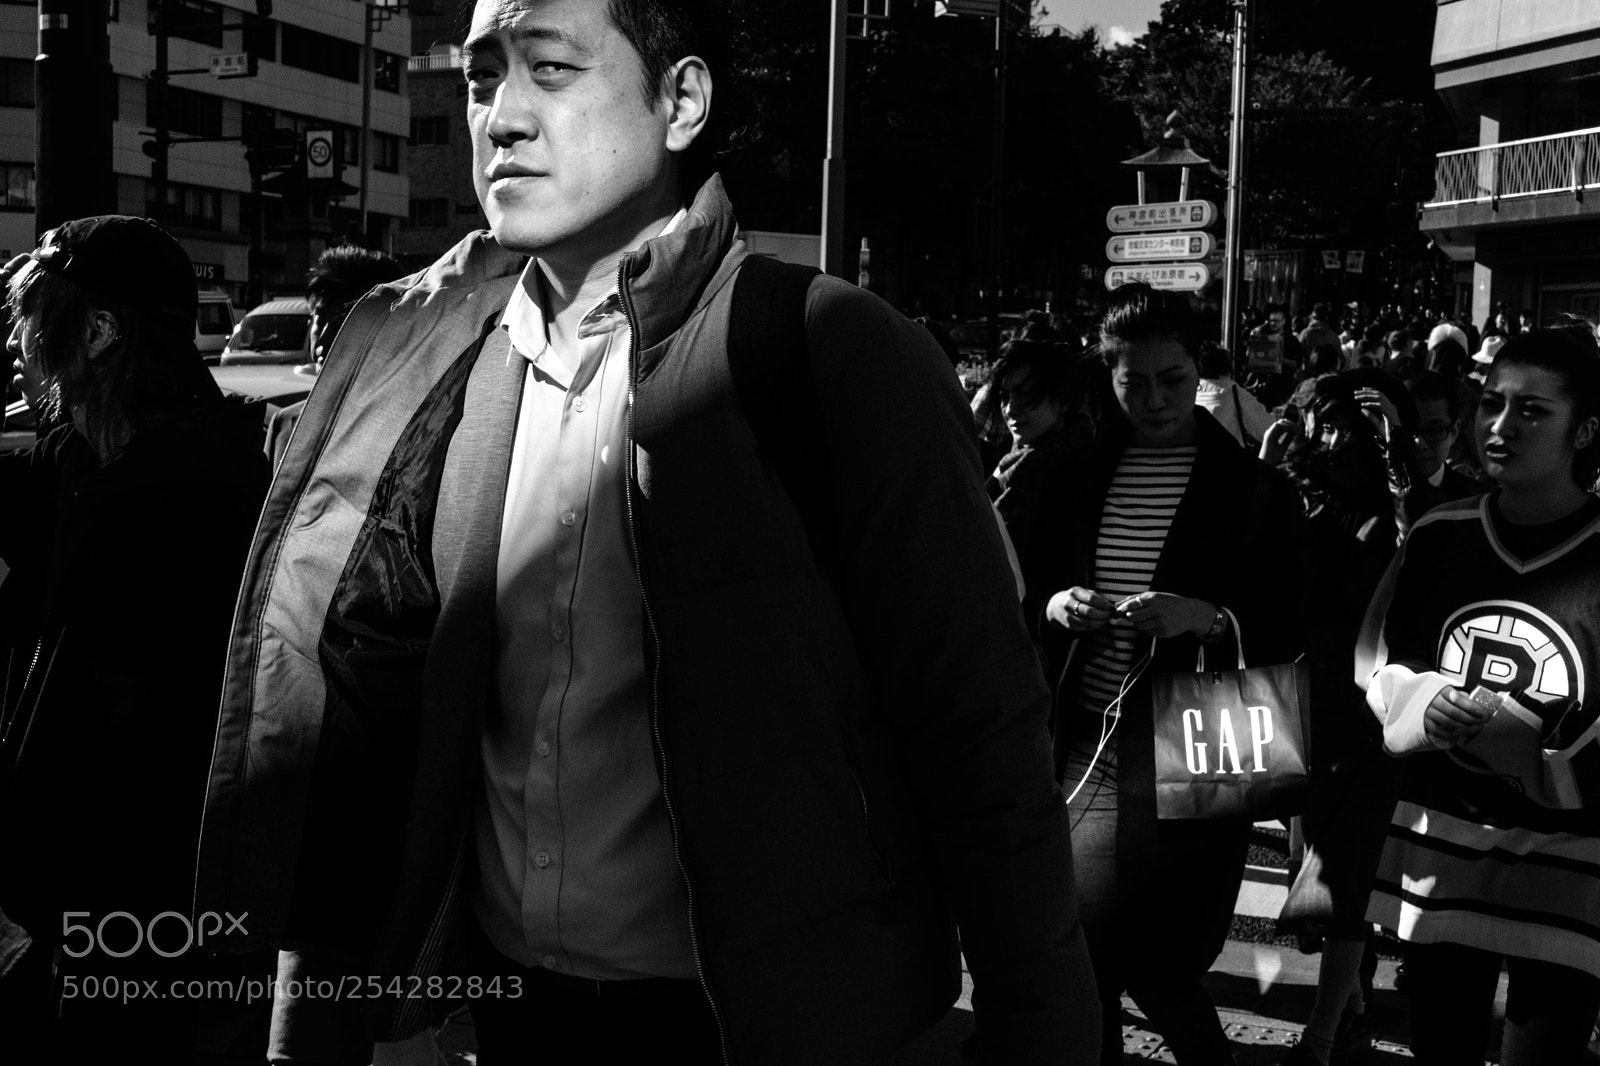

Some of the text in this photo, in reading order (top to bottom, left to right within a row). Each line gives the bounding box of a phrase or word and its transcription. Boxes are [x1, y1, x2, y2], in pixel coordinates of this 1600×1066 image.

[313, 145, 327, 159] 50
[192, 263, 215, 279] UIS
[1182, 705, 1274, 775] GAP
